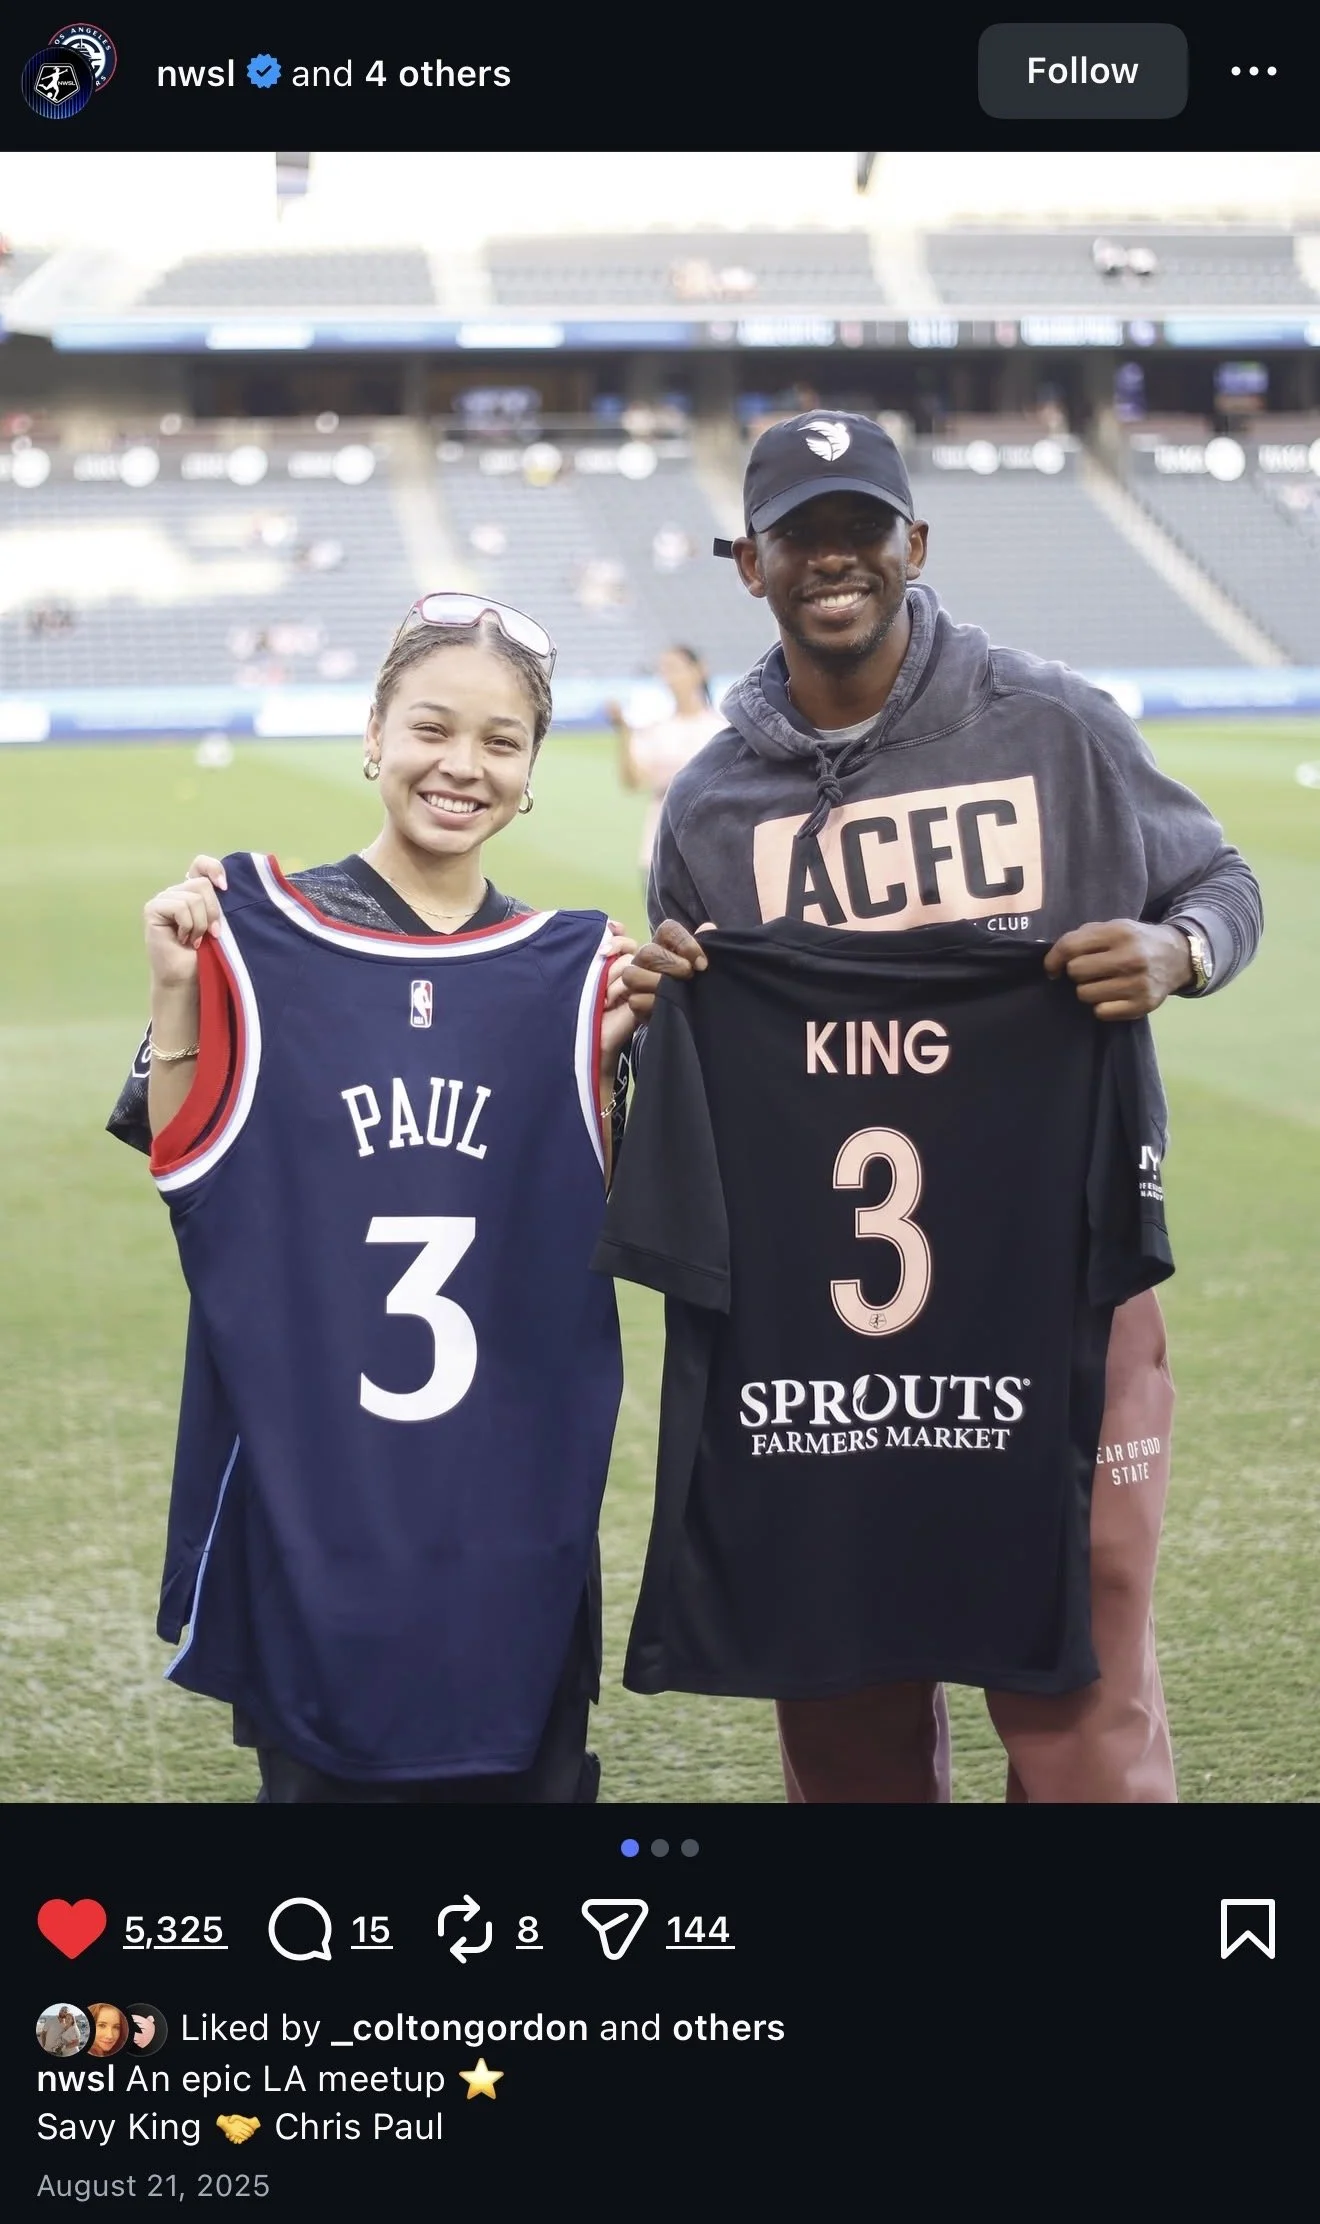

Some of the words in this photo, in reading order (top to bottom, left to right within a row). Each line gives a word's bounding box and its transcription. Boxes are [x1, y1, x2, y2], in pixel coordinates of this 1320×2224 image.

[784, 799, 1025, 925] ACFC
[987, 916, 1029, 931] CLUB
[806, 1019, 949, 1075] KING
[341, 1077, 491, 1159] PAUL
[831, 1127, 932, 1336] 3
[360, 1216, 477, 1422] 3
[739, 1374, 1025, 1428] SPROUTS
[751, 1427, 879, 1456] FARMERS
[885, 1426, 1011, 1451] MARKET
[1096, 1444, 1125, 1465] EAR
[1127, 1441, 1139, 1459] OF
[1141, 1437, 1161, 1456] GOD
[1112, 1462, 1150, 1486] STATE
